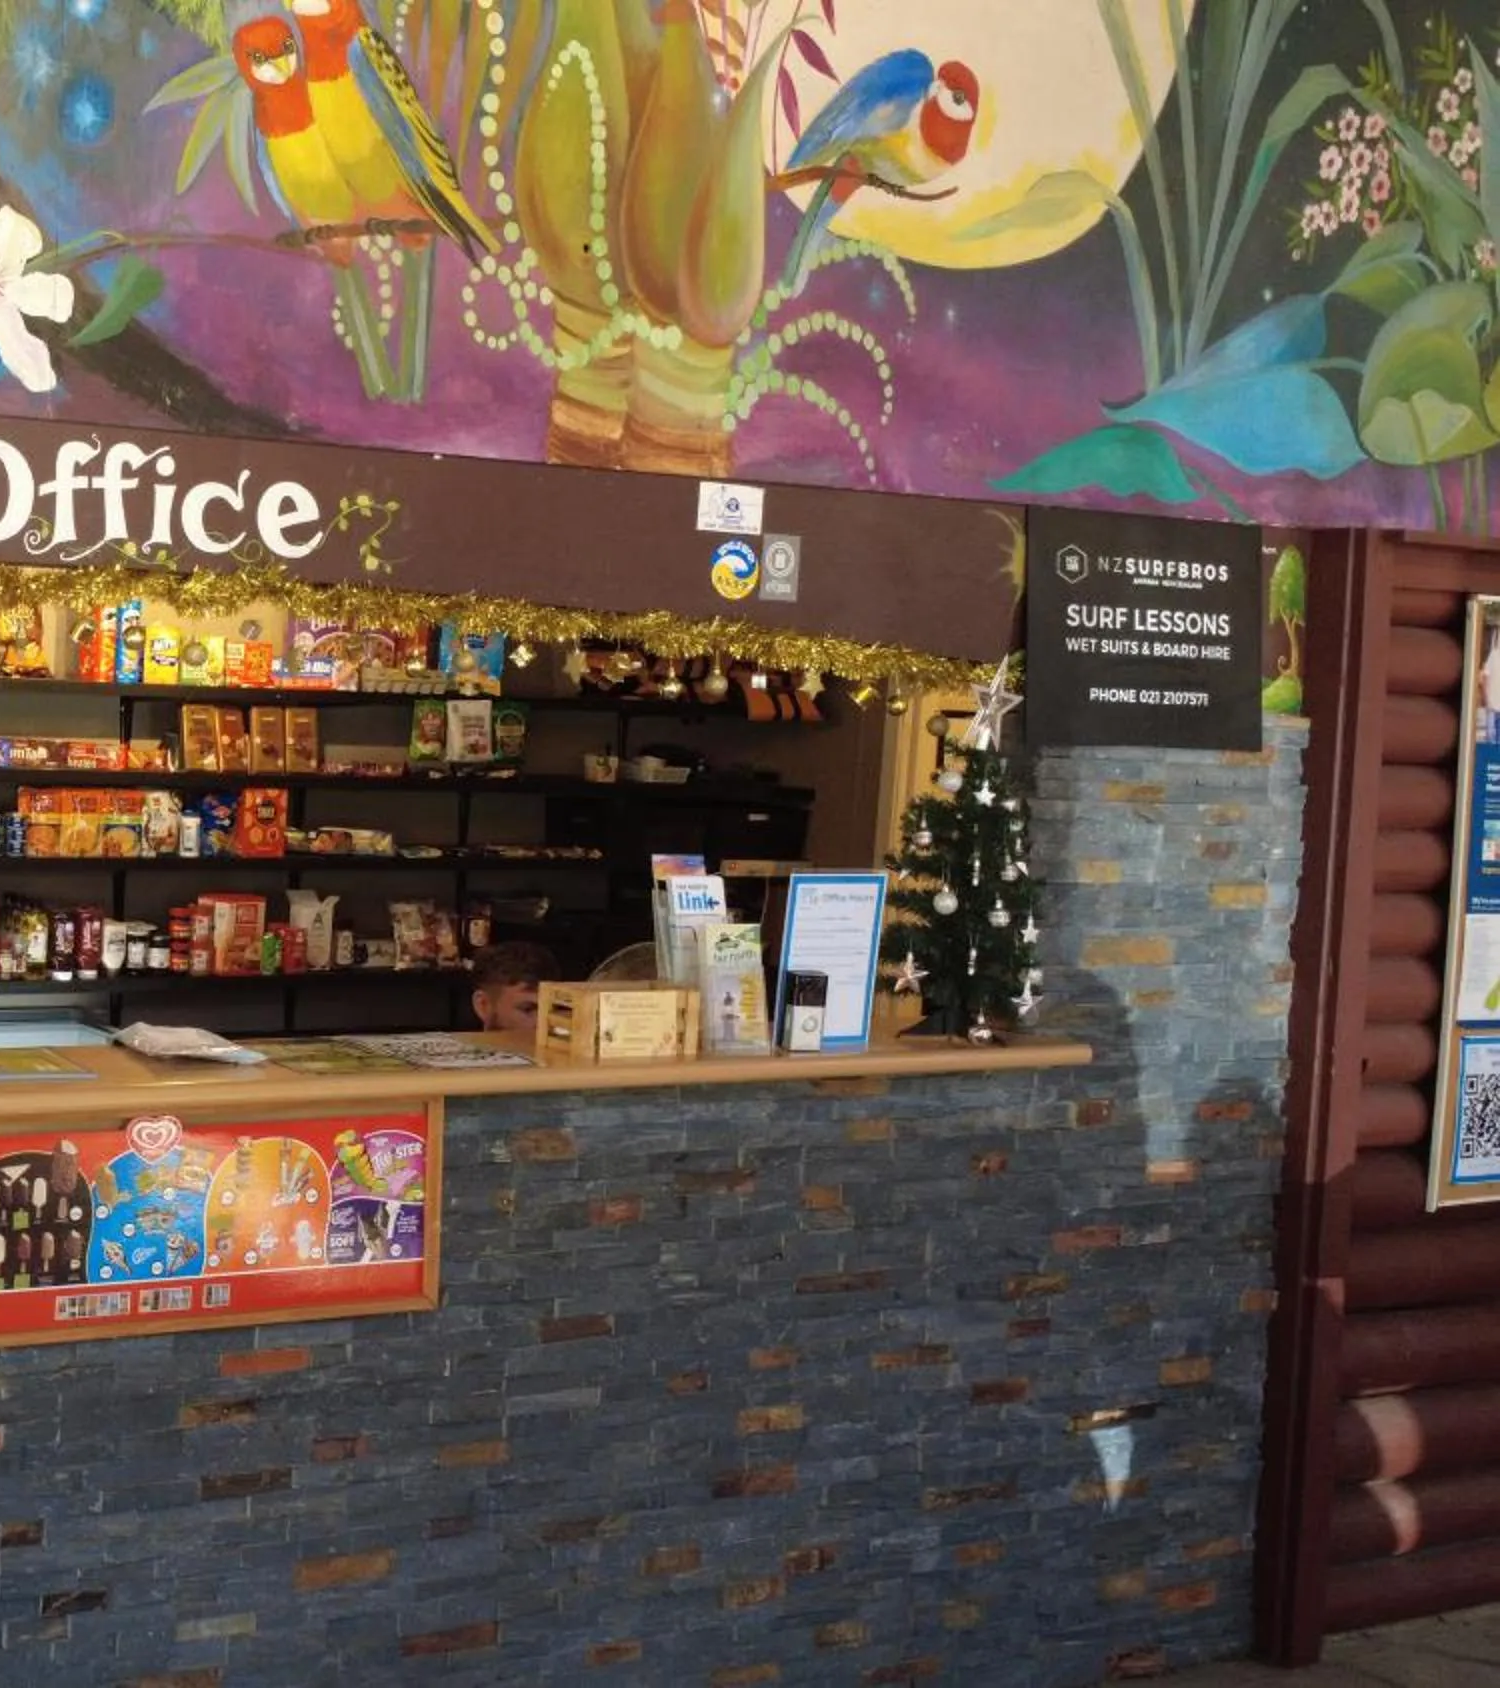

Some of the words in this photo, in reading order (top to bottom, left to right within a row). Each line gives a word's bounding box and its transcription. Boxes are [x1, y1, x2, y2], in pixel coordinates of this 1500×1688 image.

[1066, 604, 1128, 629] SURF
[1134, 608, 1231, 636] LESSONS
[1066, 637, 1097, 653] WET
[1101, 639, 1139, 655] SUITS
[1142, 641, 1150, 656] &
[1153, 643, 1199, 659] BOARD
[1201, 645, 1231, 661] HIRE
[1089, 688, 1136, 703] PHONE
[1139, 690, 1160, 704] 021
